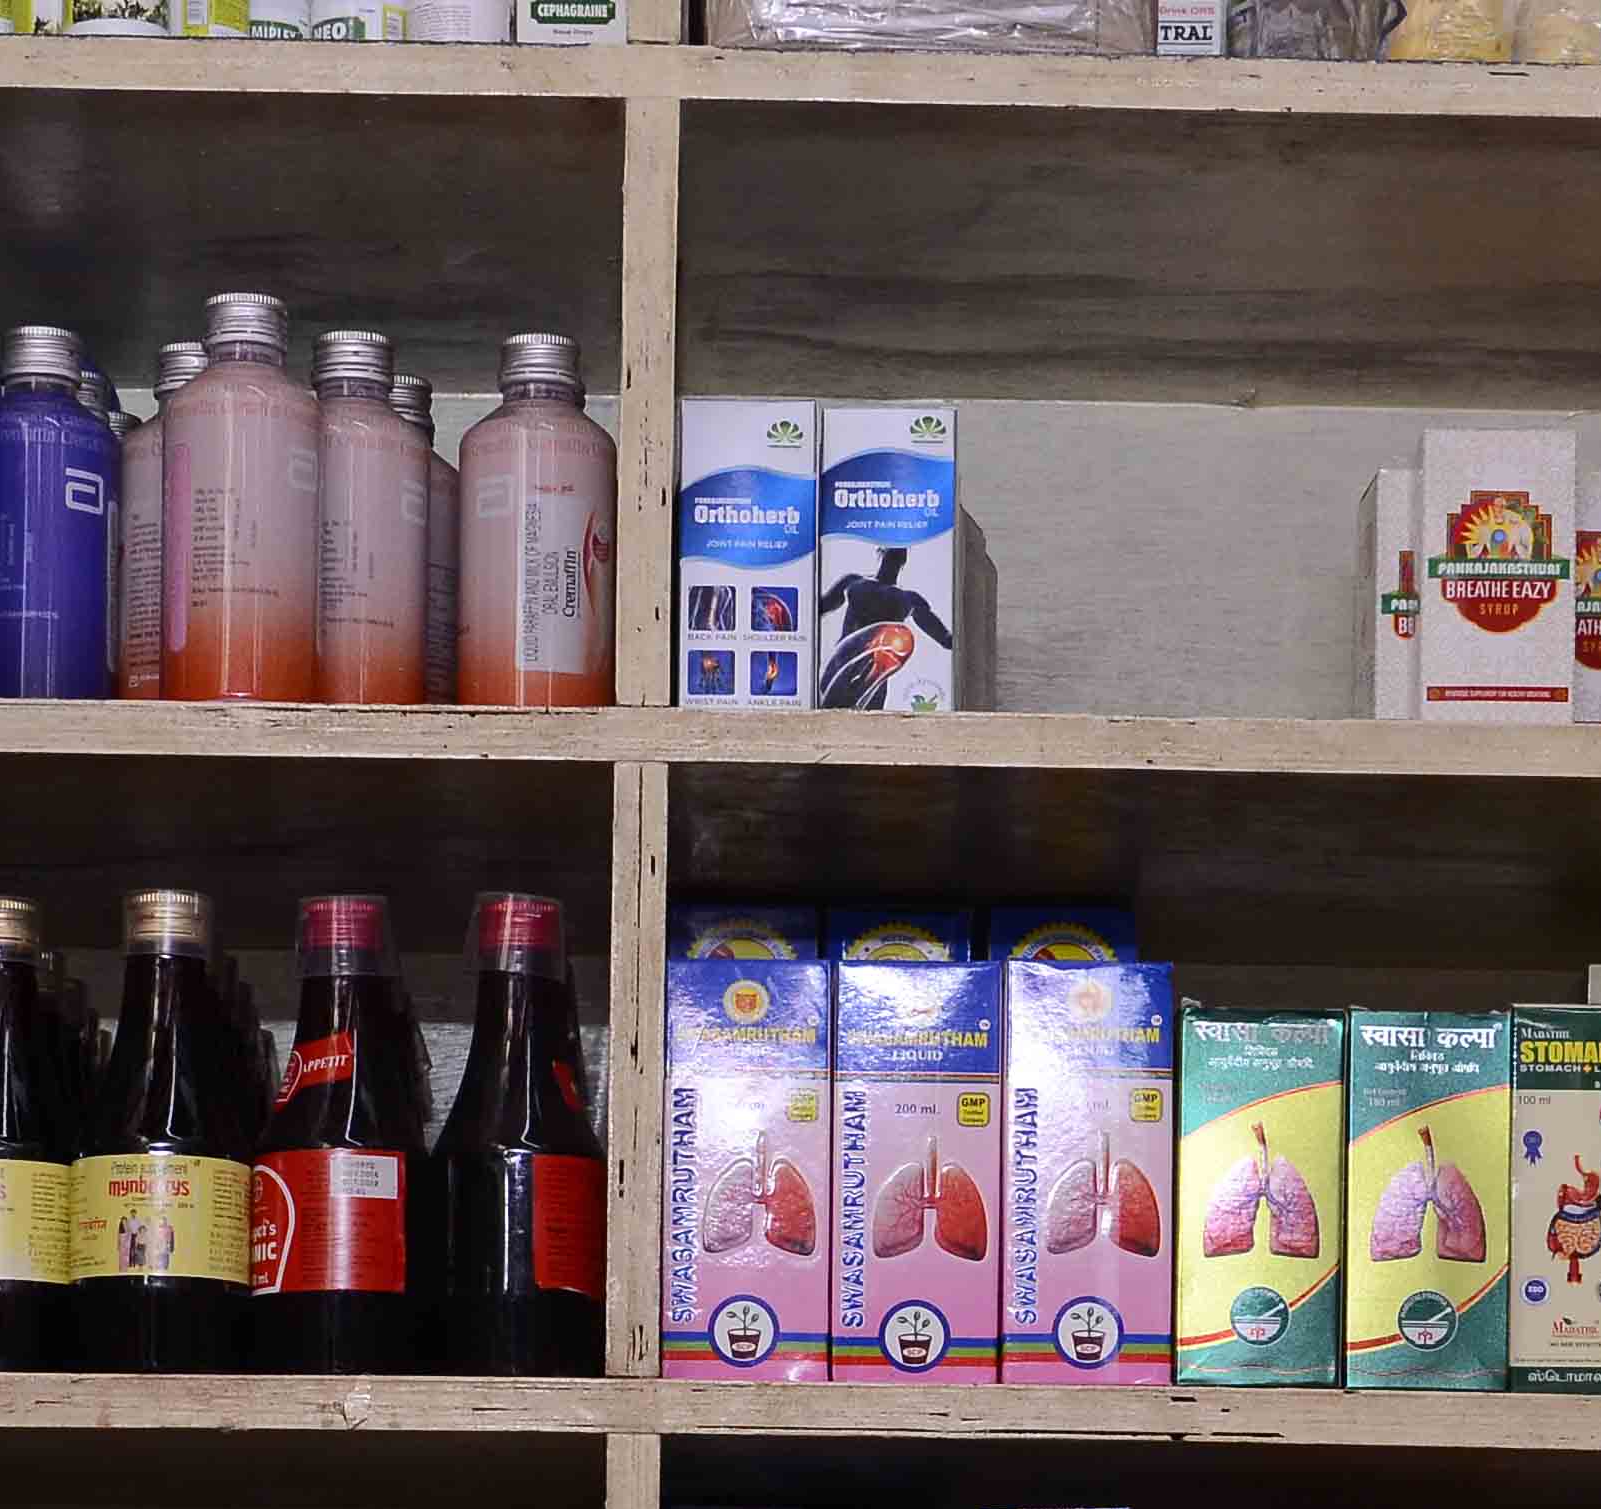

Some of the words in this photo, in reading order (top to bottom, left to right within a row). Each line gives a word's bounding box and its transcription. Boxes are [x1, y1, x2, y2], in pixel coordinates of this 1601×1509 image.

[537, 1, 608, 18] CEPHAGRAINE
[1159, 25, 1213, 41] TRAL
[833, 489, 940, 509] Orthoherb
[694, 504, 800, 525] Orthoherb
[845, 520, 874, 530] JOINT
[875, 521, 899, 530] PAIN
[900, 520, 929, 530] RELIEF
[705, 541, 733, 550] JOINT
[734, 541, 756, 550] PAIN
[757, 541, 788, 550] RELIEF
[1438, 561, 1562, 575] PANKAJAKASTHURI
[562, 550, 578, 617] Cremaffin
[1445, 580, 1510, 600] BREATHE
[1512, 580, 1552, 600] EAZY
[1479, 602, 1519, 617] SYRUP
[1519, 1064, 1583, 1074] STOMACH
[961, 1097, 987, 1108] GMP
[108, 1177, 190, 1199] mynberrys
[672, 1087, 697, 1324] SWASAMRUTHAM
[842, 1091, 867, 1328] SWASAMRUTHAM
[1014, 1087, 1039, 1325] SWASAMRUTHAM
